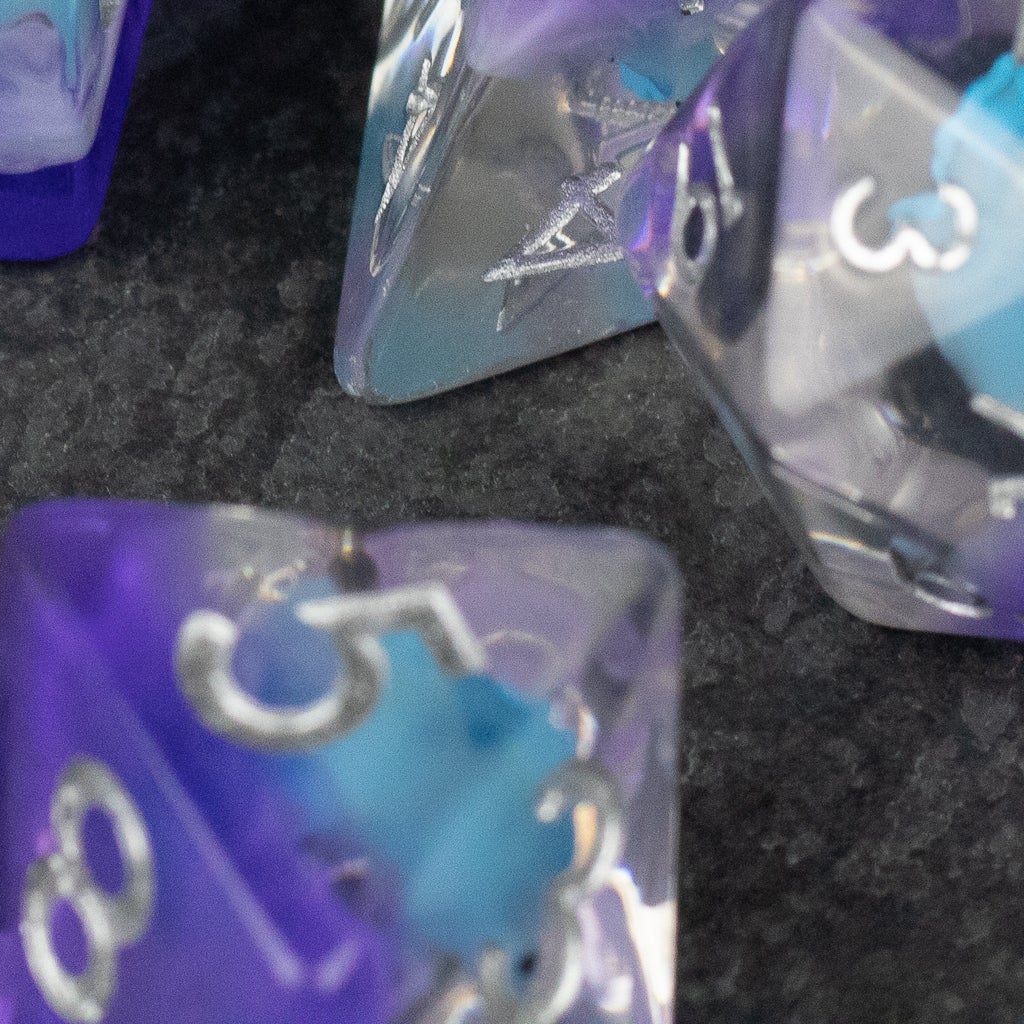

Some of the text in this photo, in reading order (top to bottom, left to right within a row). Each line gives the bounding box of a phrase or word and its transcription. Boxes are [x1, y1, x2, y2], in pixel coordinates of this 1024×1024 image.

[831, 174, 979, 274] 3
[173, 579, 484, 756] 5
[20, 756, 154, 1024] 8
